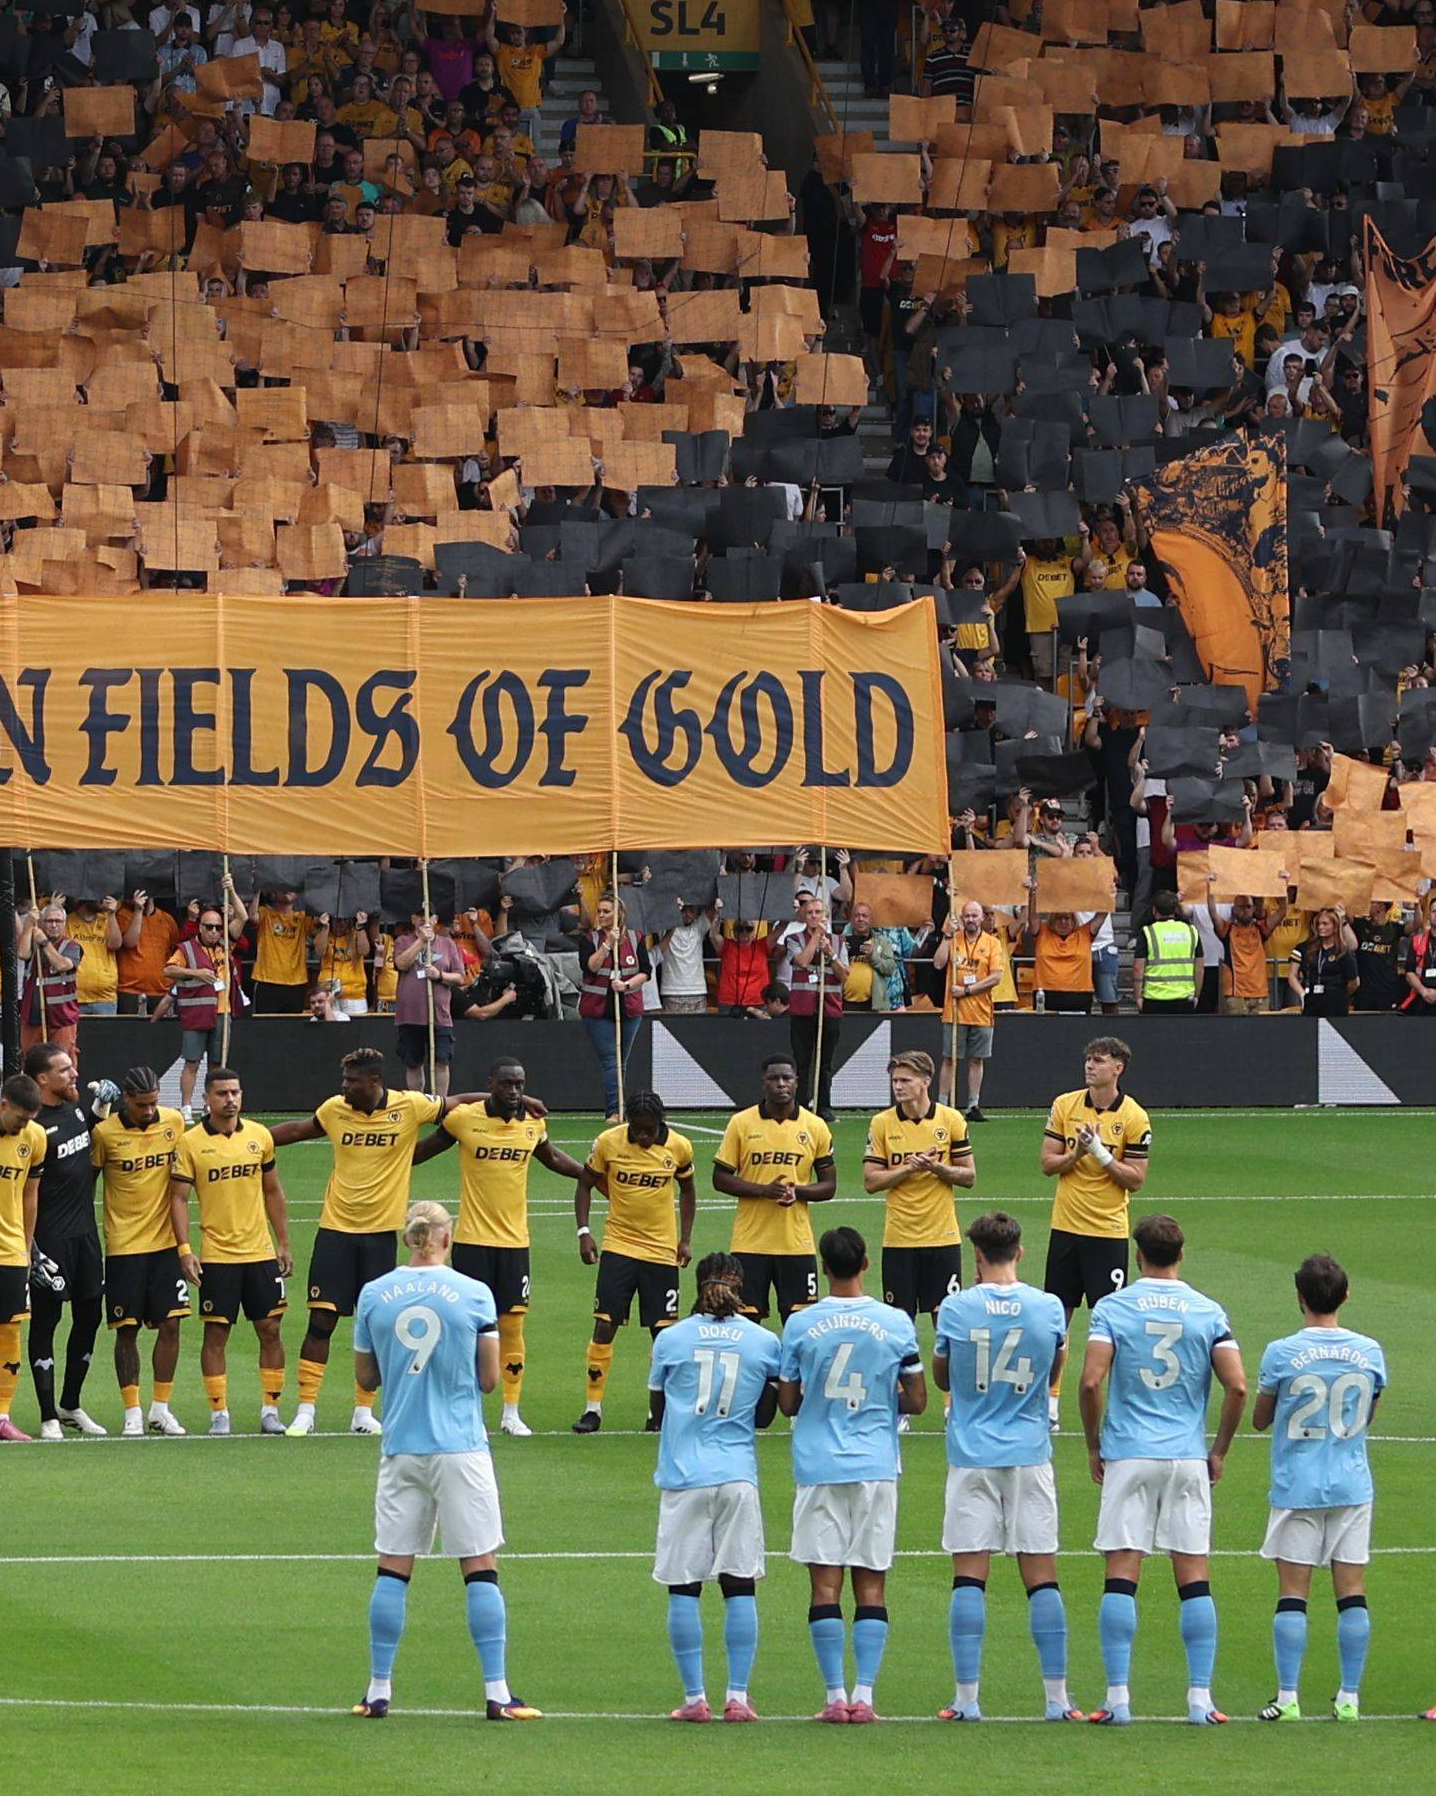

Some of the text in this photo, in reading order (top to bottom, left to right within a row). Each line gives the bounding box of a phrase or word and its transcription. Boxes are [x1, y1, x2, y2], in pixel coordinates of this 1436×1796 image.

[650, 0, 726, 36] SL4
[1037, 571, 1067, 582] DEBET
[78, 668, 420, 788] FIELDS
[446, 669, 591, 789] OF
[617, 670, 915, 789] GOLD
[73, 933, 105, 944] AstroPay
[1361, 942, 1392, 953] DEBET
[341, 1132, 400, 1148] DEBET
[122, 1151, 177, 1172] DEBET
[475, 1146, 532, 1163] DEBET
[751, 1152, 805, 1167] DEBET
[208, 1163, 262, 1183] DEBET
[615, 1171, 672, 1189] DEBET
[380, 1282, 461, 1305] HAALAND
[807, 1273, 817, 1296] 5
[947, 1273, 961, 1296] 6
[985, 1300, 1021, 1317] NICO
[698, 1324, 745, 1343] DOKU
[807, 1314, 888, 1342] REIJNDERS
[394, 1305, 442, 1375] 9
[969, 1328, 1035, 1394] 14
[1139, 1321, 1184, 1390] 3
[1289, 1345, 1369, 1371] BERNARDO
[693, 1348, 740, 1418] 11
[824, 1342, 867, 1412] 4
[1287, 1372, 1373, 1440] 20
